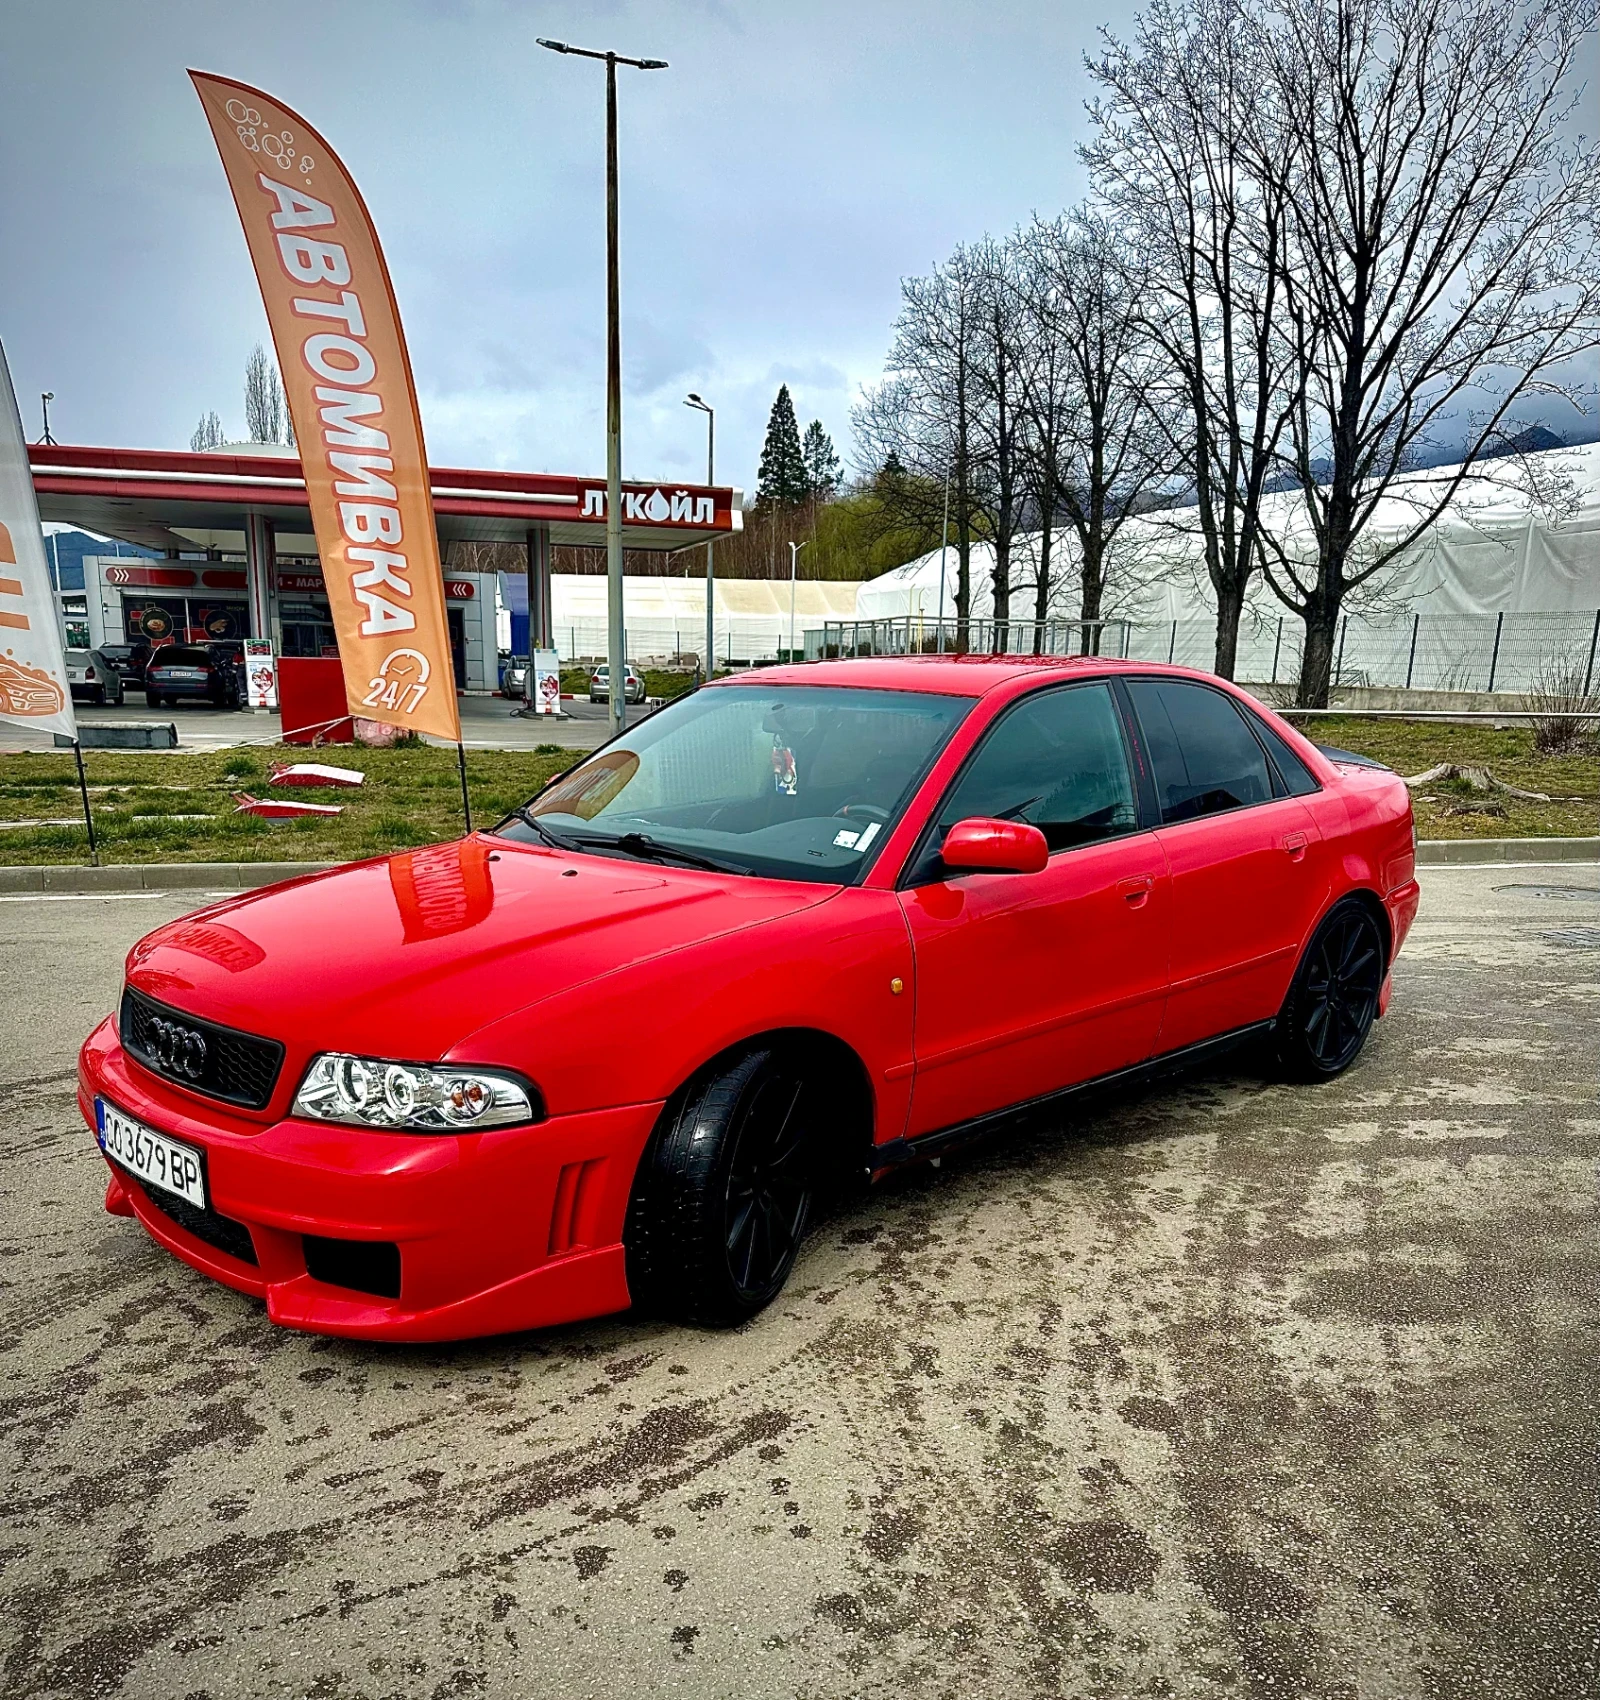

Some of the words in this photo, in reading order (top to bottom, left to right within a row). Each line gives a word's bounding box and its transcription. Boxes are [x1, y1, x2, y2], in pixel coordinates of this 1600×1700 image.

[256, 171, 416, 638] АВТОМИВКА
[296, 577, 325, 588] МАР
[362, 678, 429, 714] 24/7
[125, 1126, 166, 1181] 3679
[170, 1149, 197, 1195] BP
